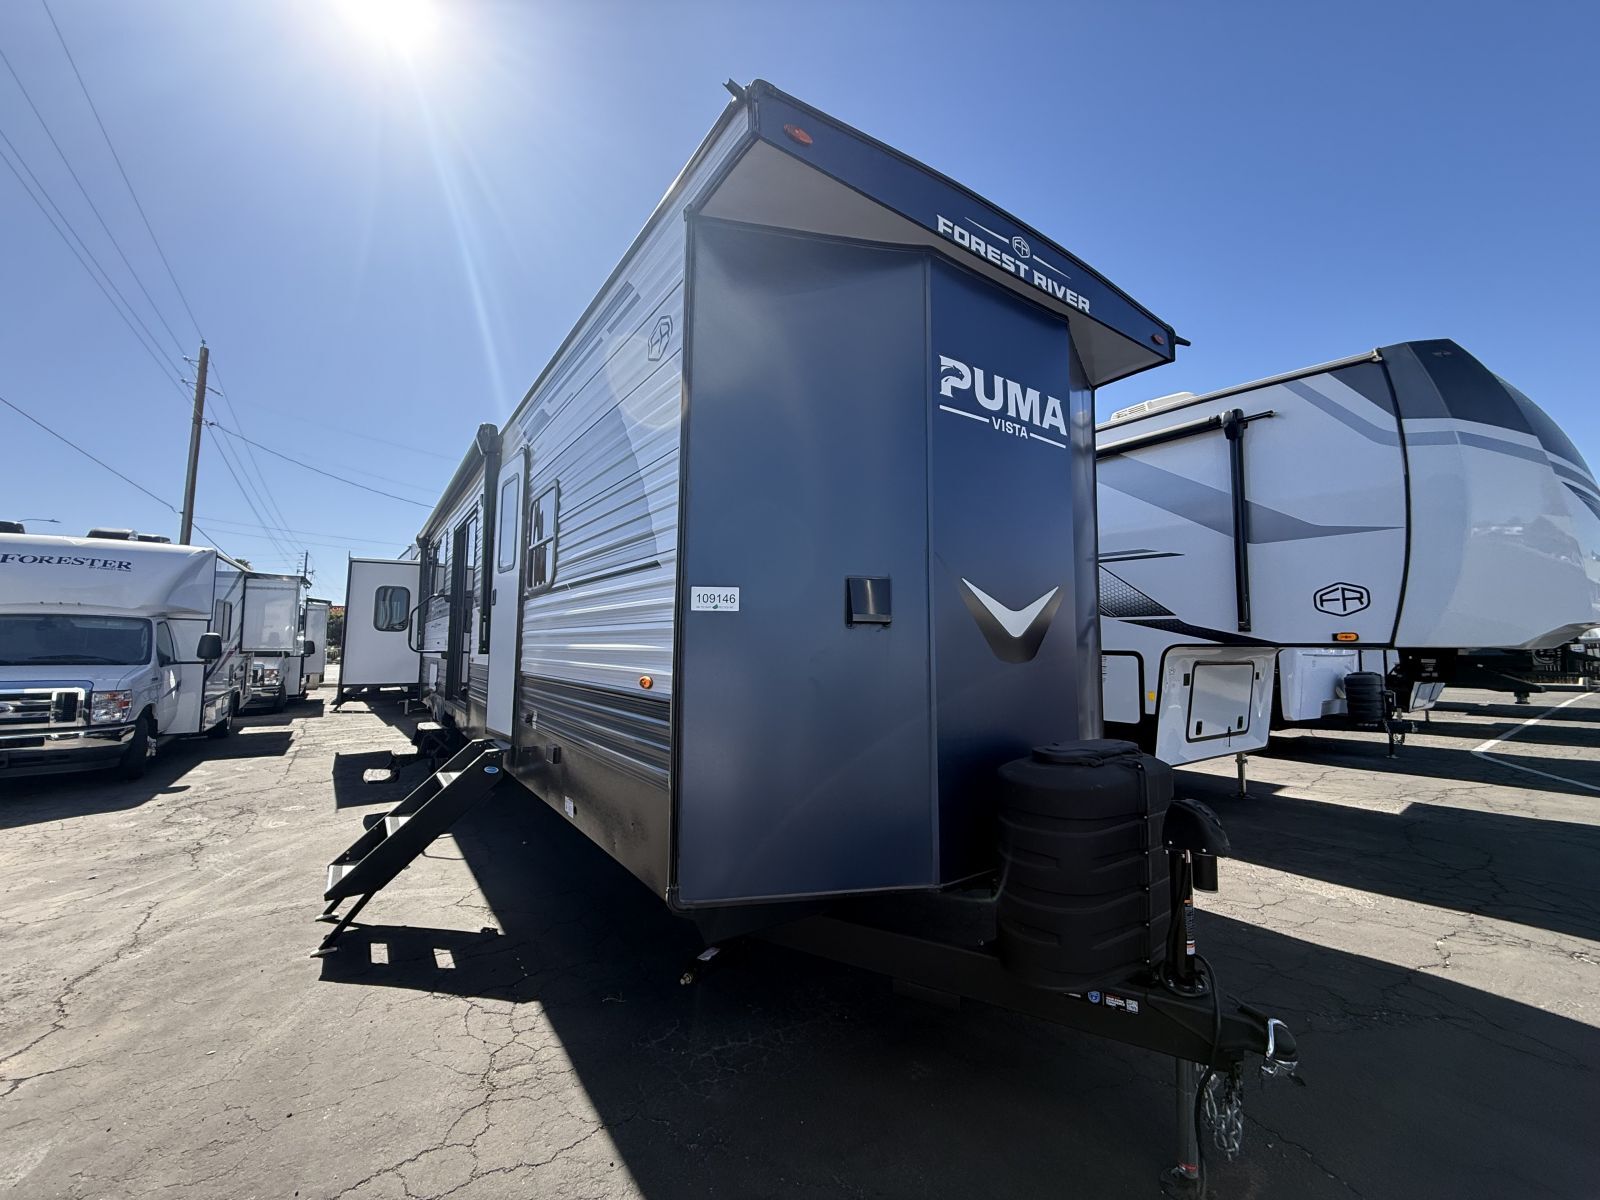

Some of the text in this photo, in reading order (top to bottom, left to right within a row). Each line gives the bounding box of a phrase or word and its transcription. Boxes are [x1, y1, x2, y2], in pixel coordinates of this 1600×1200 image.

[936, 214, 1090, 314] FOREST RIVER
[938, 354, 1067, 436] PUMA
[990, 415, 1028, 440] VISTA
[0, 553, 132, 569] FORESTER
[696, 593, 736, 604] 109146
